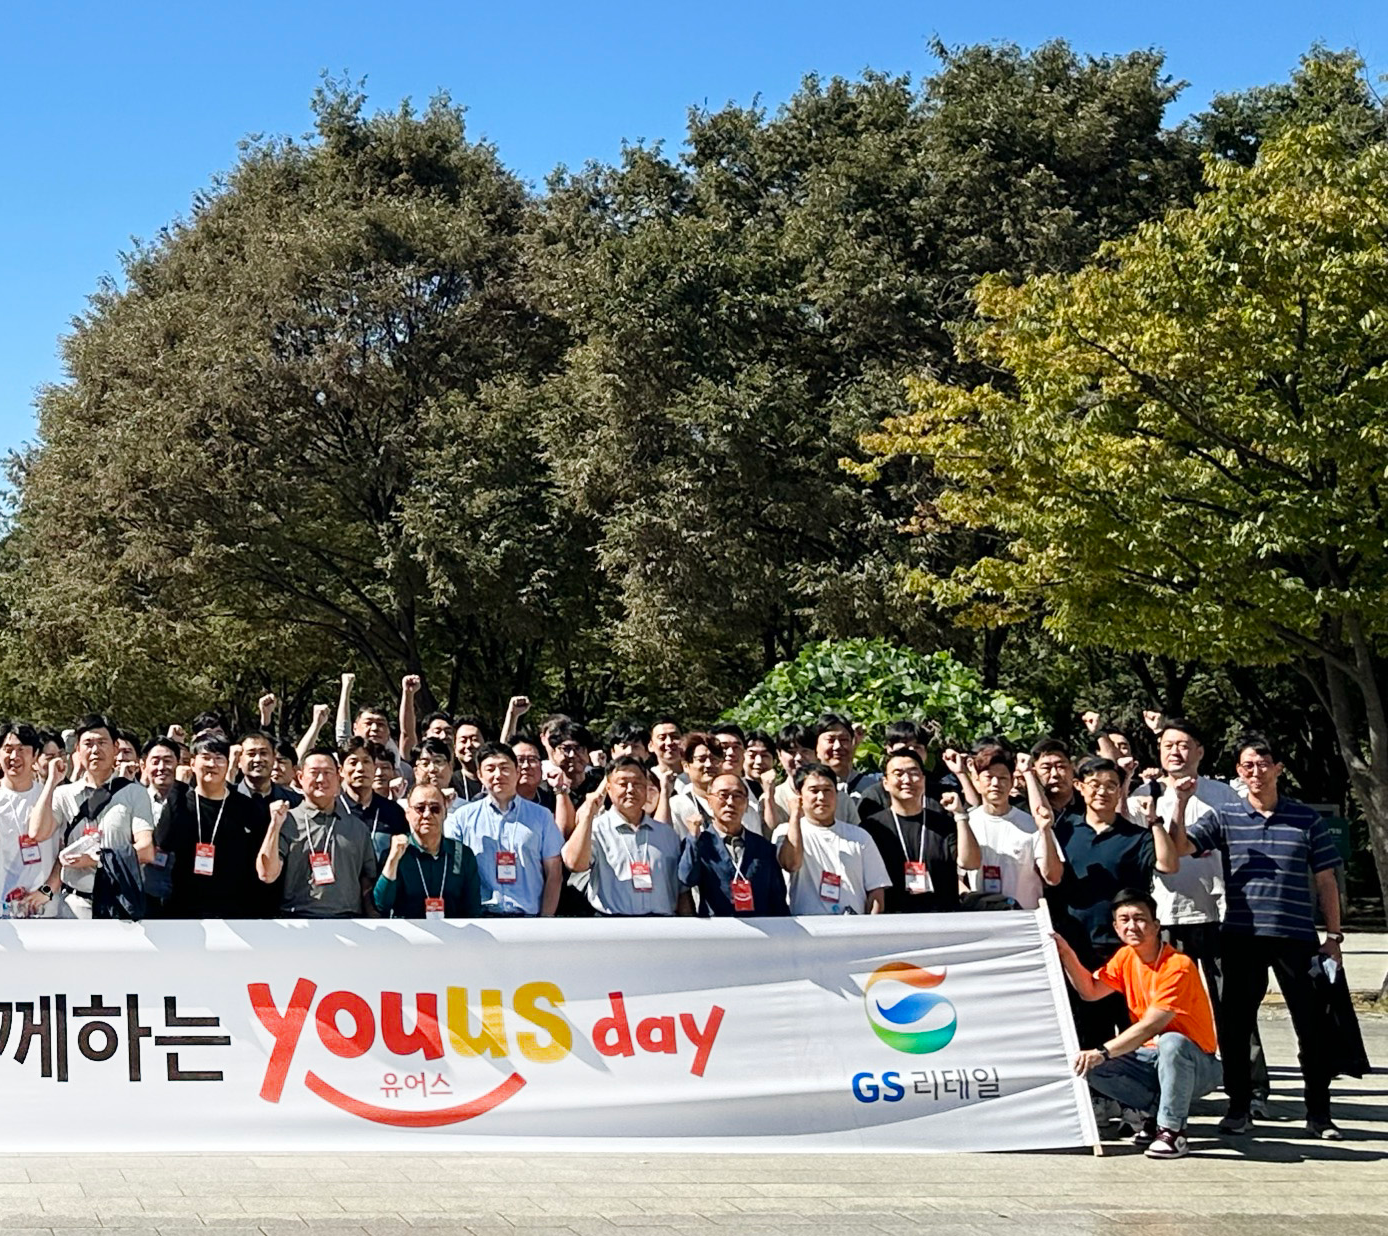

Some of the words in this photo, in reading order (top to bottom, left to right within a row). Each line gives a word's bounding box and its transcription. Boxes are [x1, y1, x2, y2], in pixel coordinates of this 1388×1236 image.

[247, 977, 573, 1104] youus
[592, 991, 726, 1078] day
[379, 1070, 454, 1099] 유어스
[851, 1071, 906, 1103] GS
[911, 1067, 1001, 1101] 리테일
